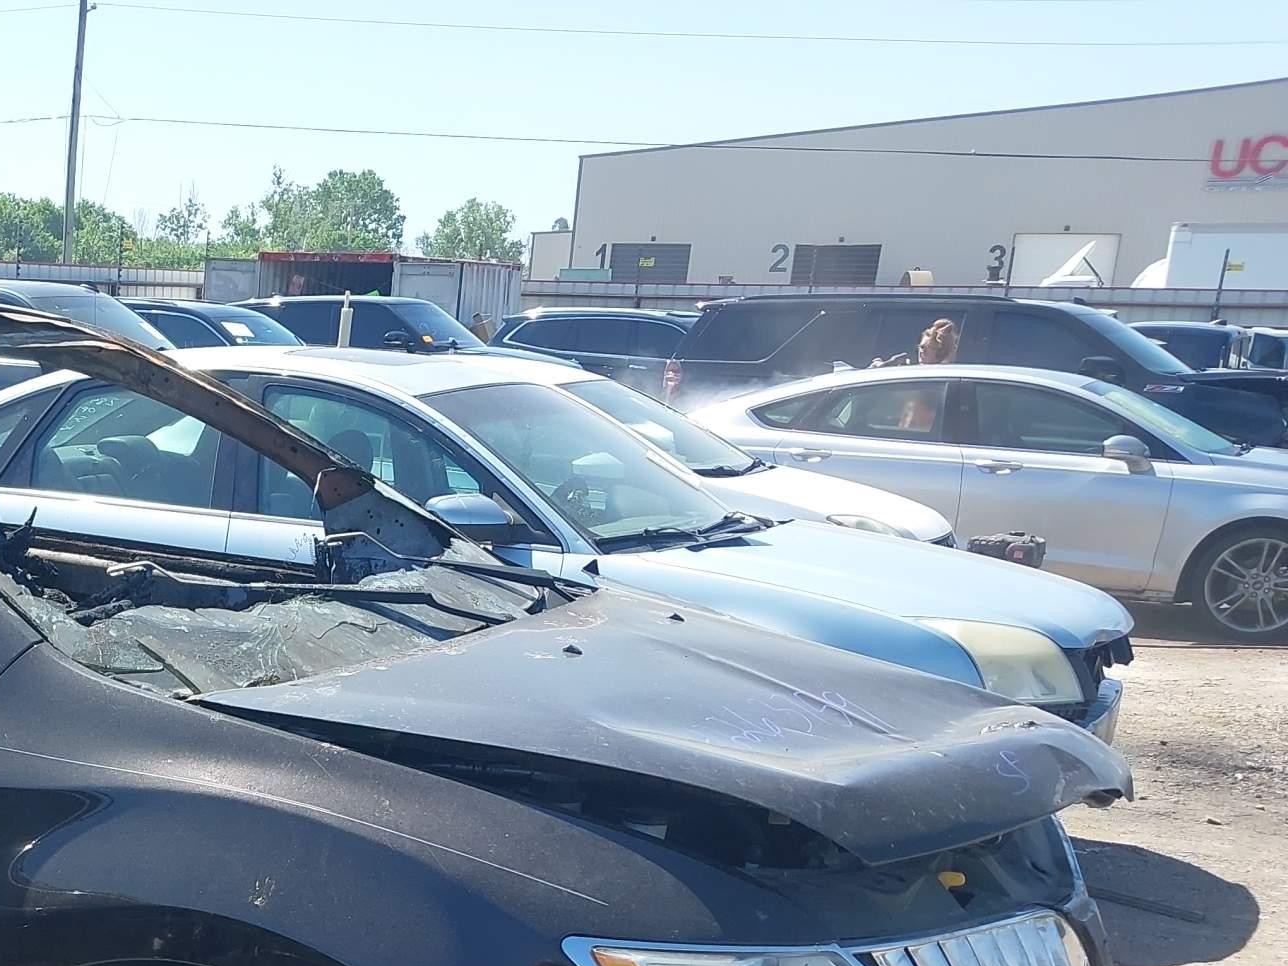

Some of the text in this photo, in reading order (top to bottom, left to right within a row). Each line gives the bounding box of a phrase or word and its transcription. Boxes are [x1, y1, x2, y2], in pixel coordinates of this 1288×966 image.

[595, 243, 608, 270] 1
[769, 244, 790, 273] 2
[987, 244, 1007, 271] 3
